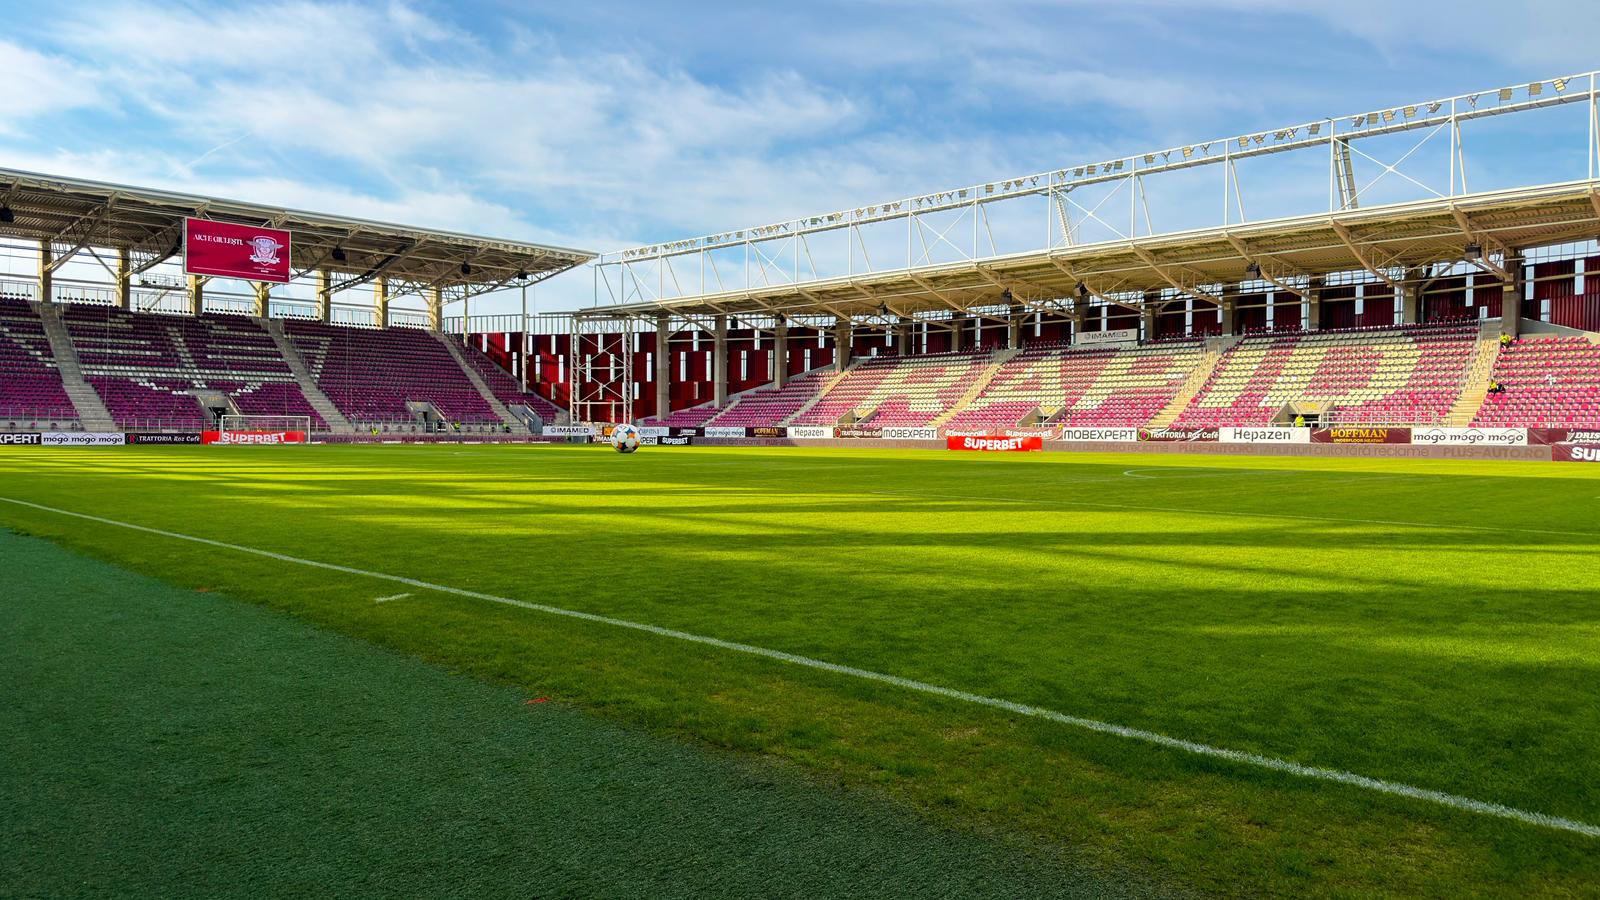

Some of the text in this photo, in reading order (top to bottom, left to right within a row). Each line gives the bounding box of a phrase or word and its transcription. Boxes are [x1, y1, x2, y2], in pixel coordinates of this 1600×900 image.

[221, 432, 286, 443] SUPERBET
[794, 428, 825, 437] Hepazen
[883, 429, 936, 438] MOBEXPERT
[1063, 430, 1135, 440] MOBEXPERT
[1202, 430, 1219, 439] Café
[1233, 428, 1291, 442] Hepazen
[1330, 429, 1388, 438] HOFFMAN
[963, 438, 1024, 450] SUPERBET
[1414, 434, 1524, 444] mogo mogo mogo
[1443, 447, 1544, 458] PLUS-AUTO.RO
